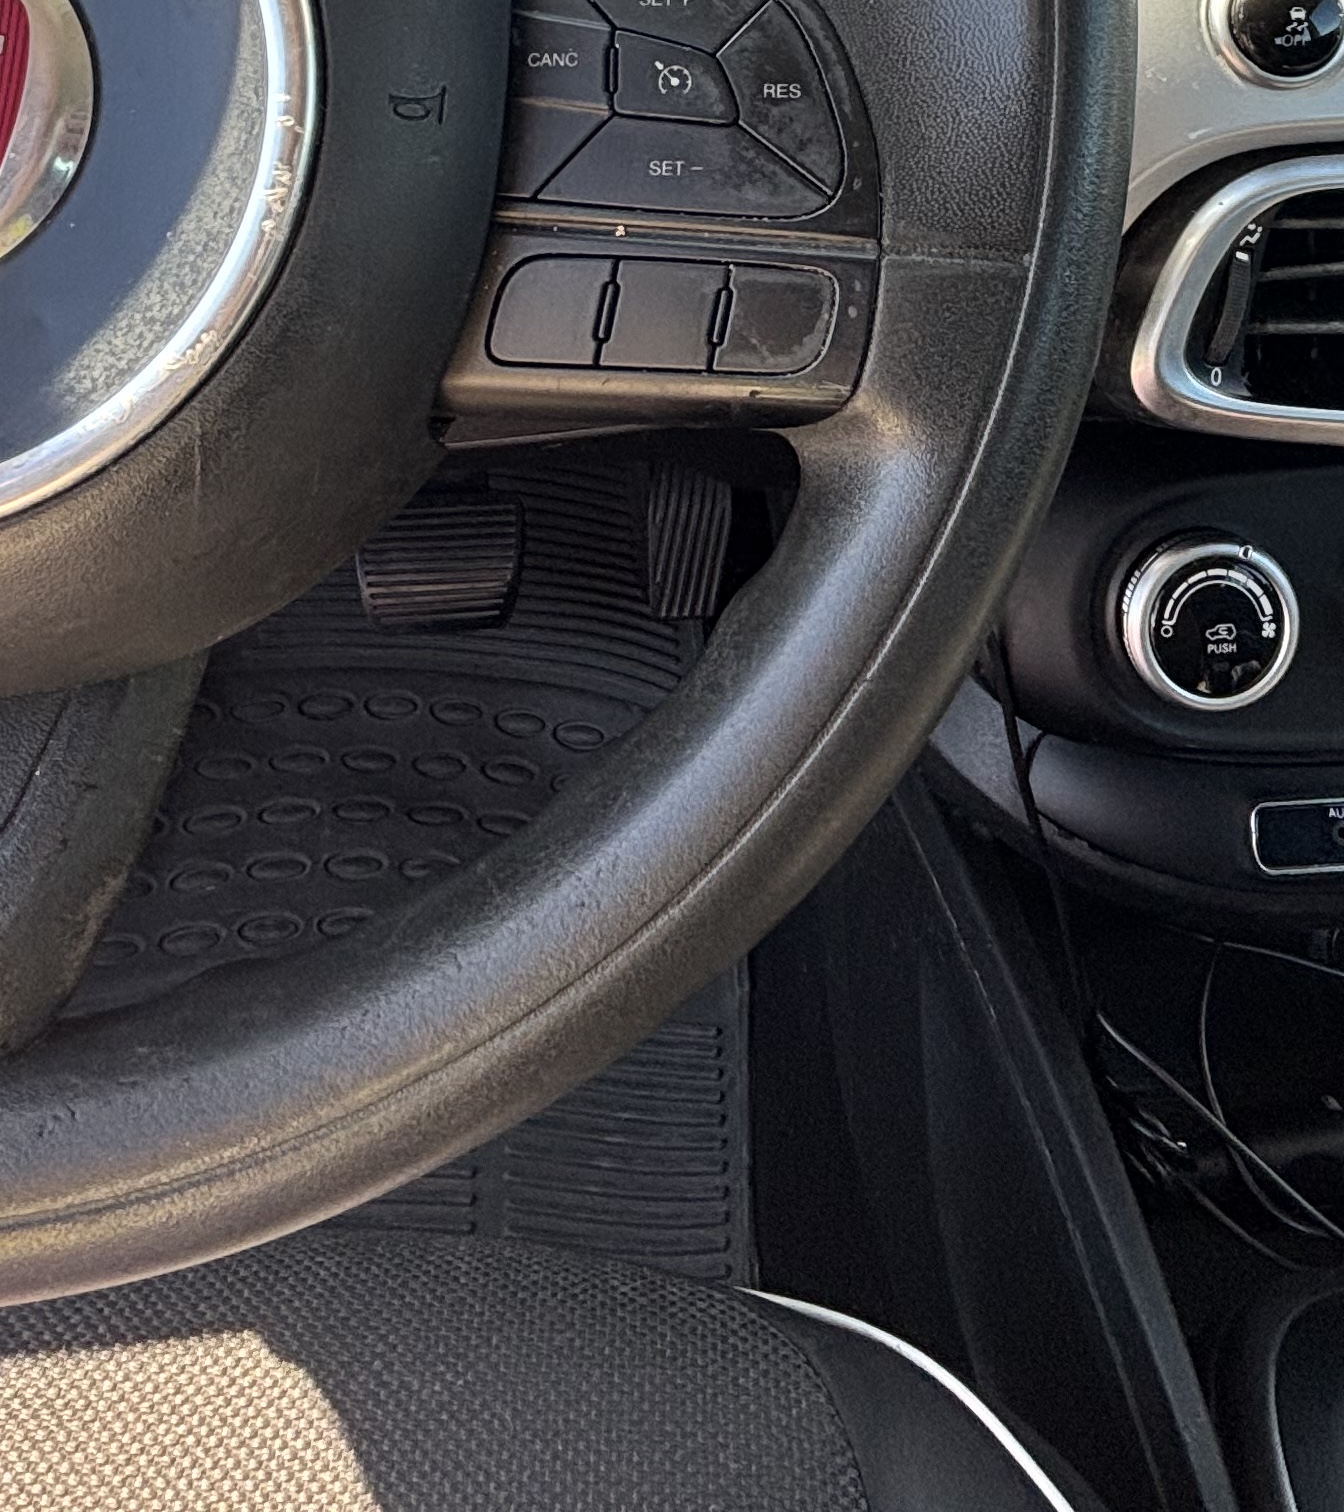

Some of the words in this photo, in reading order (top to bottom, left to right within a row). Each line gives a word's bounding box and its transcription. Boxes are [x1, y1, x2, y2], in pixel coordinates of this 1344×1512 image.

[527, 52, 579, 68] CANC
[763, 83, 802, 99] RES
[648, 161, 685, 177] SET
[1207, 642, 1237, 654] PUSH
